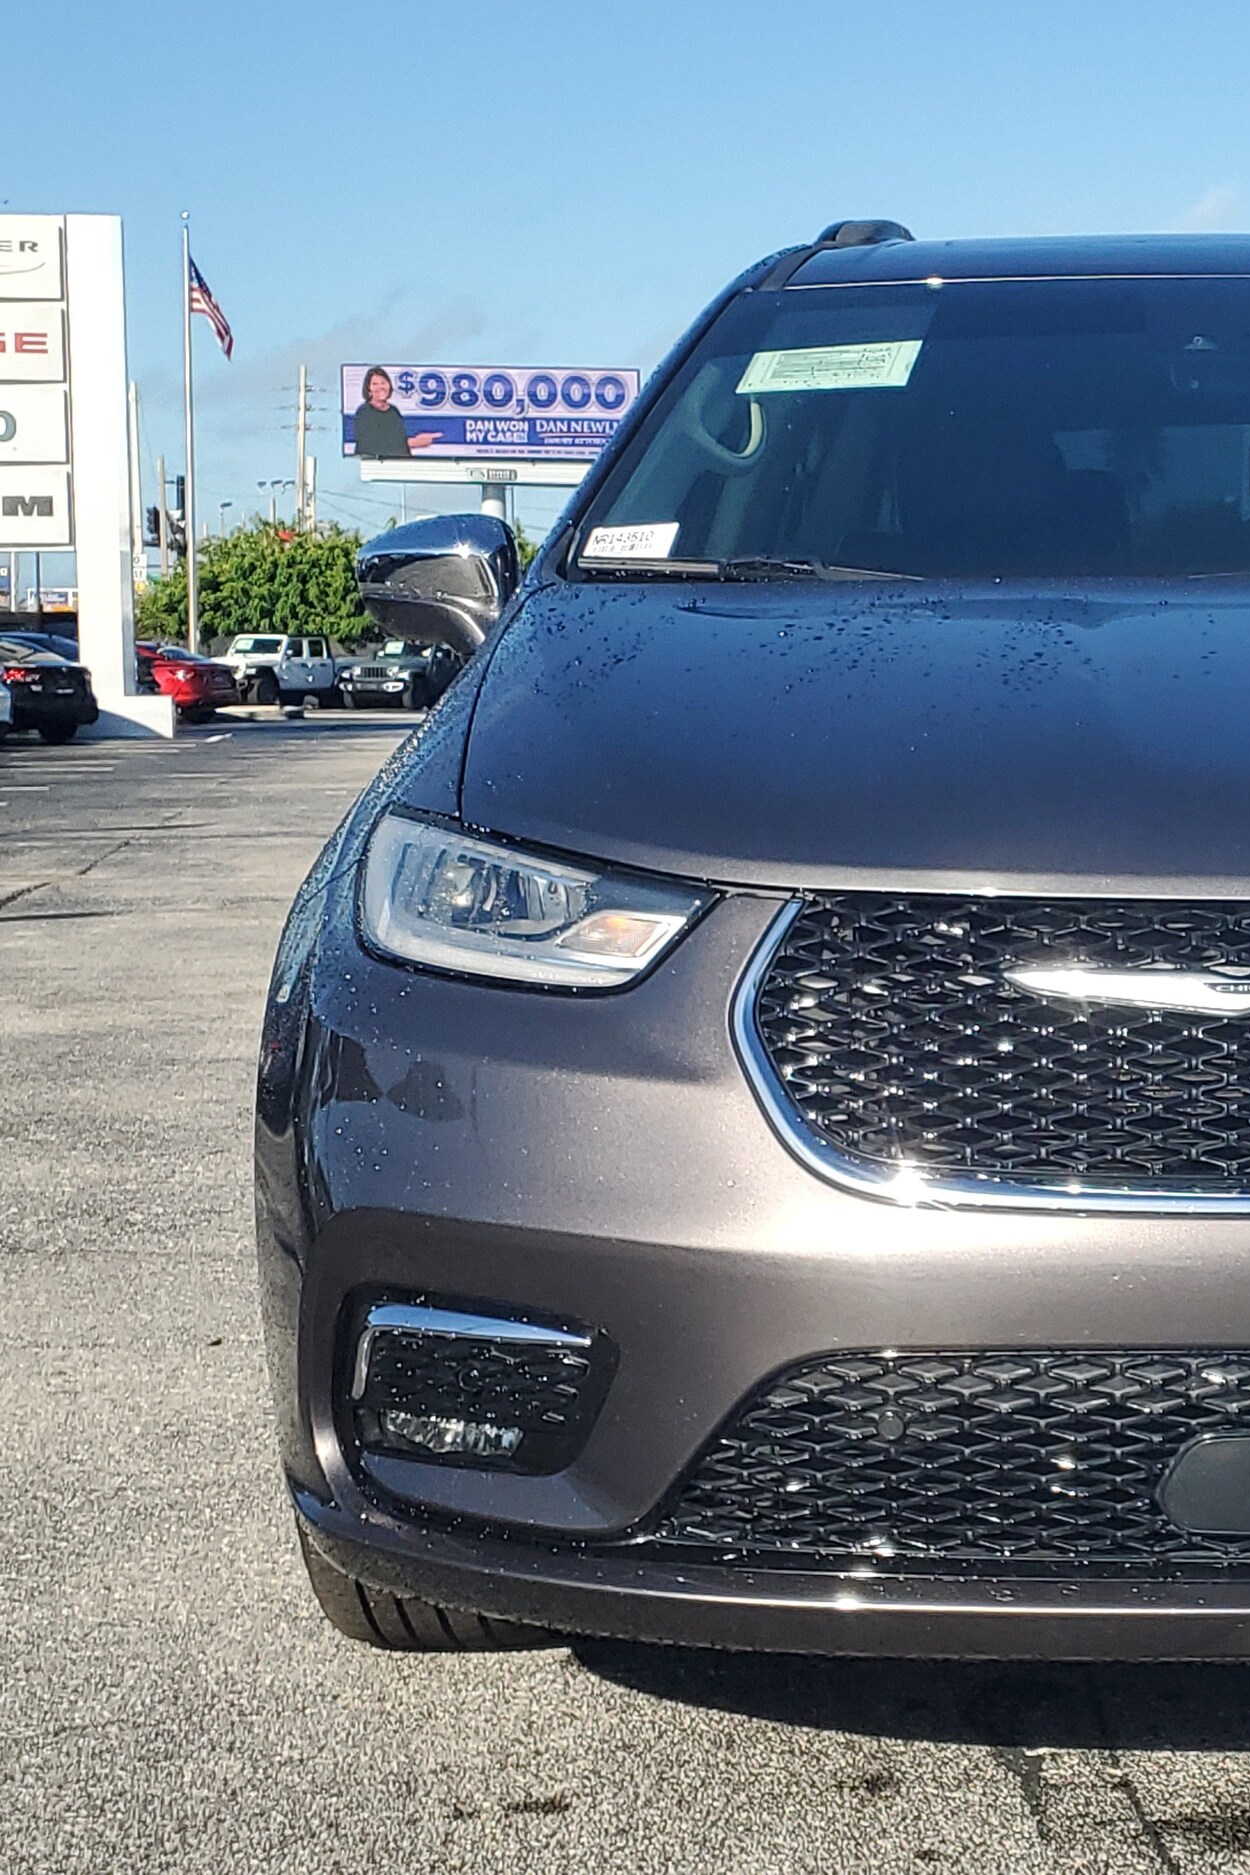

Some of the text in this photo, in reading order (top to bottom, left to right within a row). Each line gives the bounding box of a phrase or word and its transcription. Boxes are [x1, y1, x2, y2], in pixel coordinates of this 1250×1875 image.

[0, 332, 49, 354] E
[396, 370, 628, 415] $980,000
[466, 419, 529, 432] DAN WON
[536, 420, 568, 433] DAN
[466, 431, 486, 443] MY
